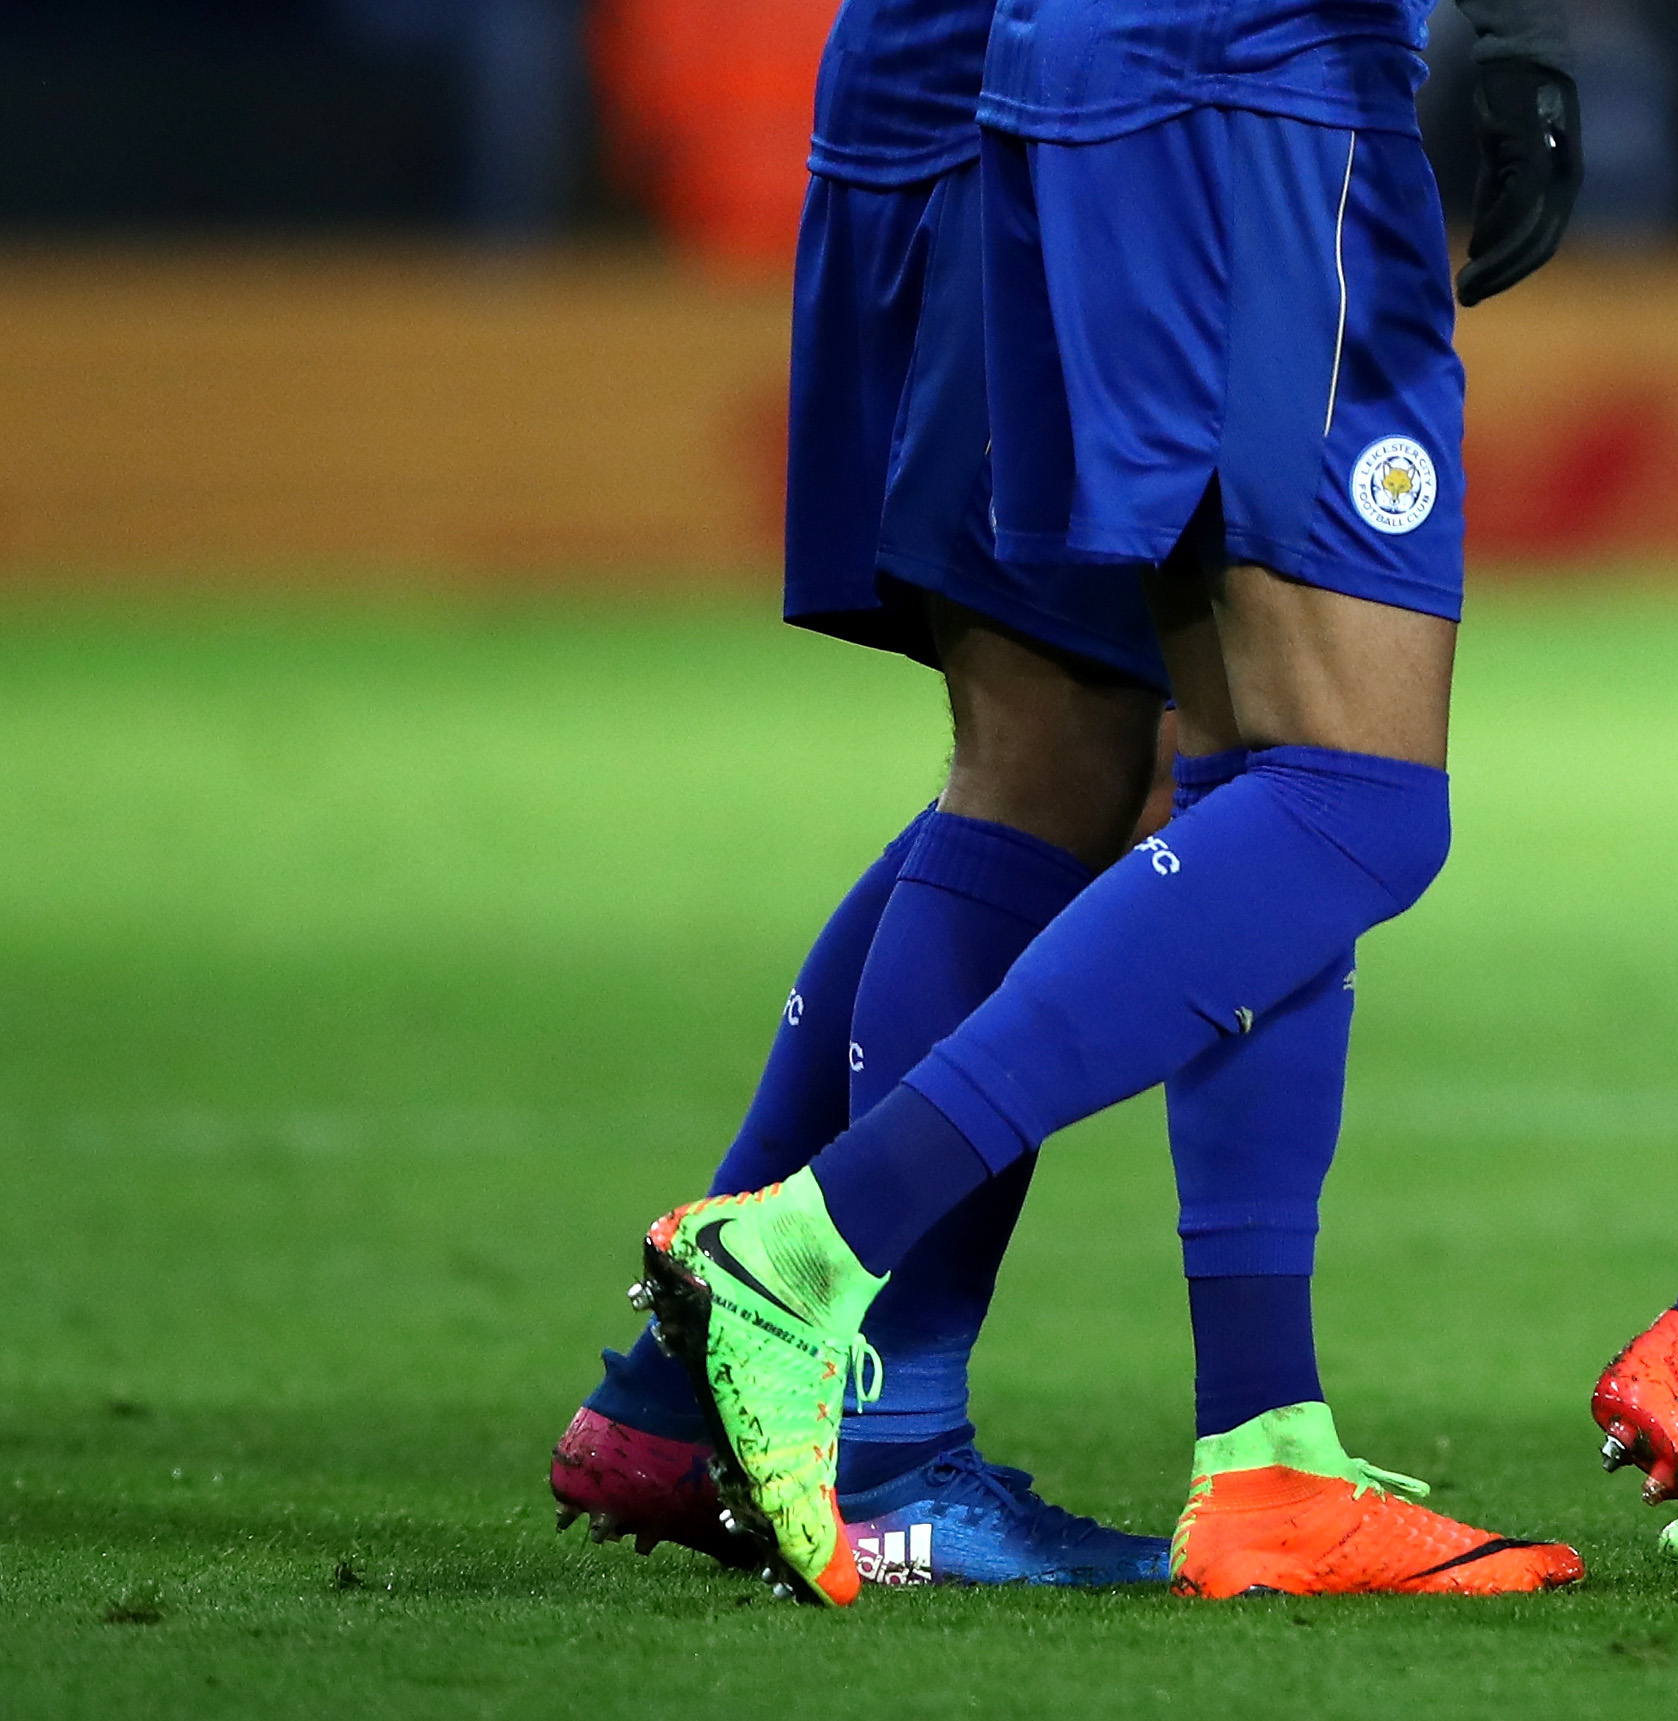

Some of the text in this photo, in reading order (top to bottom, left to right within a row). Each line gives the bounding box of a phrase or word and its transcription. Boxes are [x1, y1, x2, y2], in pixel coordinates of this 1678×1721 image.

[1361, 443, 1433, 487] LEICESTER CITY
[1358, 483, 1431, 527] FOOTBALL CLUB
